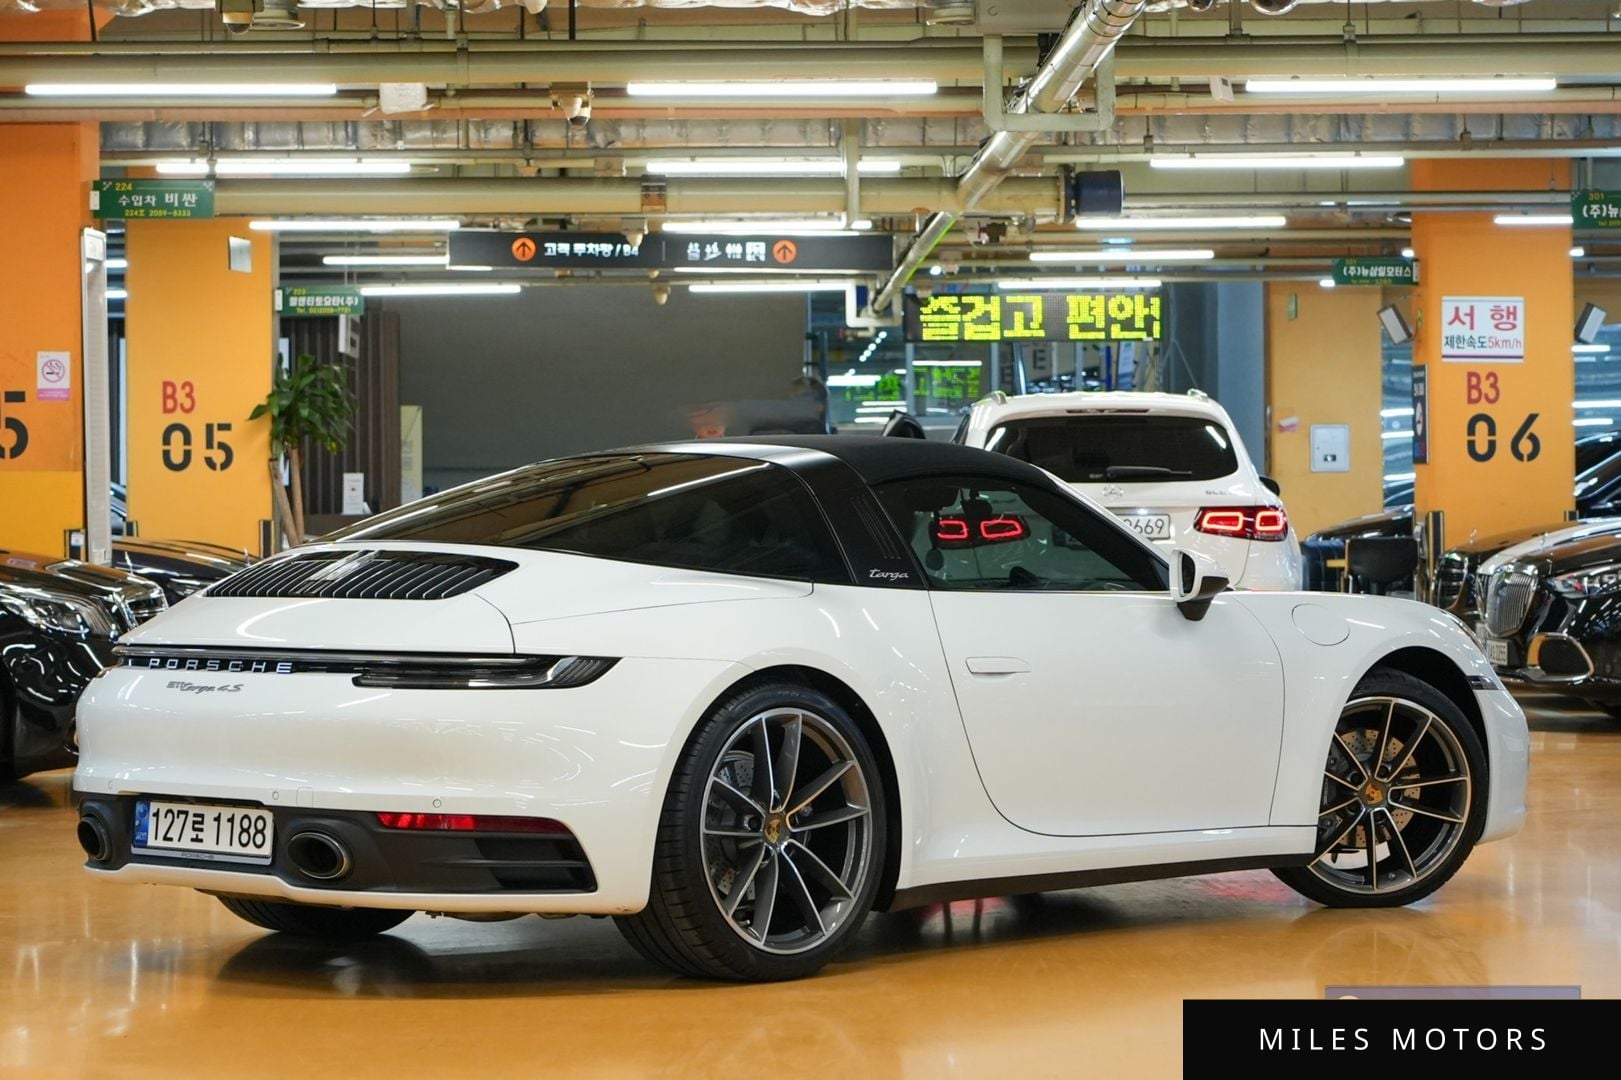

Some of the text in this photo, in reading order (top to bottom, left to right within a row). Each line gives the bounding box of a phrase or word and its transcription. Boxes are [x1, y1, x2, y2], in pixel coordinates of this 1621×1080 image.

[115, 183, 133, 191] 224
[118, 193, 198, 207] 수입차 비싼
[1582, 204, 1621, 218] (주)뉴
[920, 296, 1045, 340] 즐겁고
[162, 381, 196, 414] B3
[1467, 371, 1500, 405] B3
[162, 423, 234, 472] 05
[1467, 413, 1541, 463] 06
[149, 658, 293, 673] PORSCHE
[152, 808, 267, 849] 127로 1188
